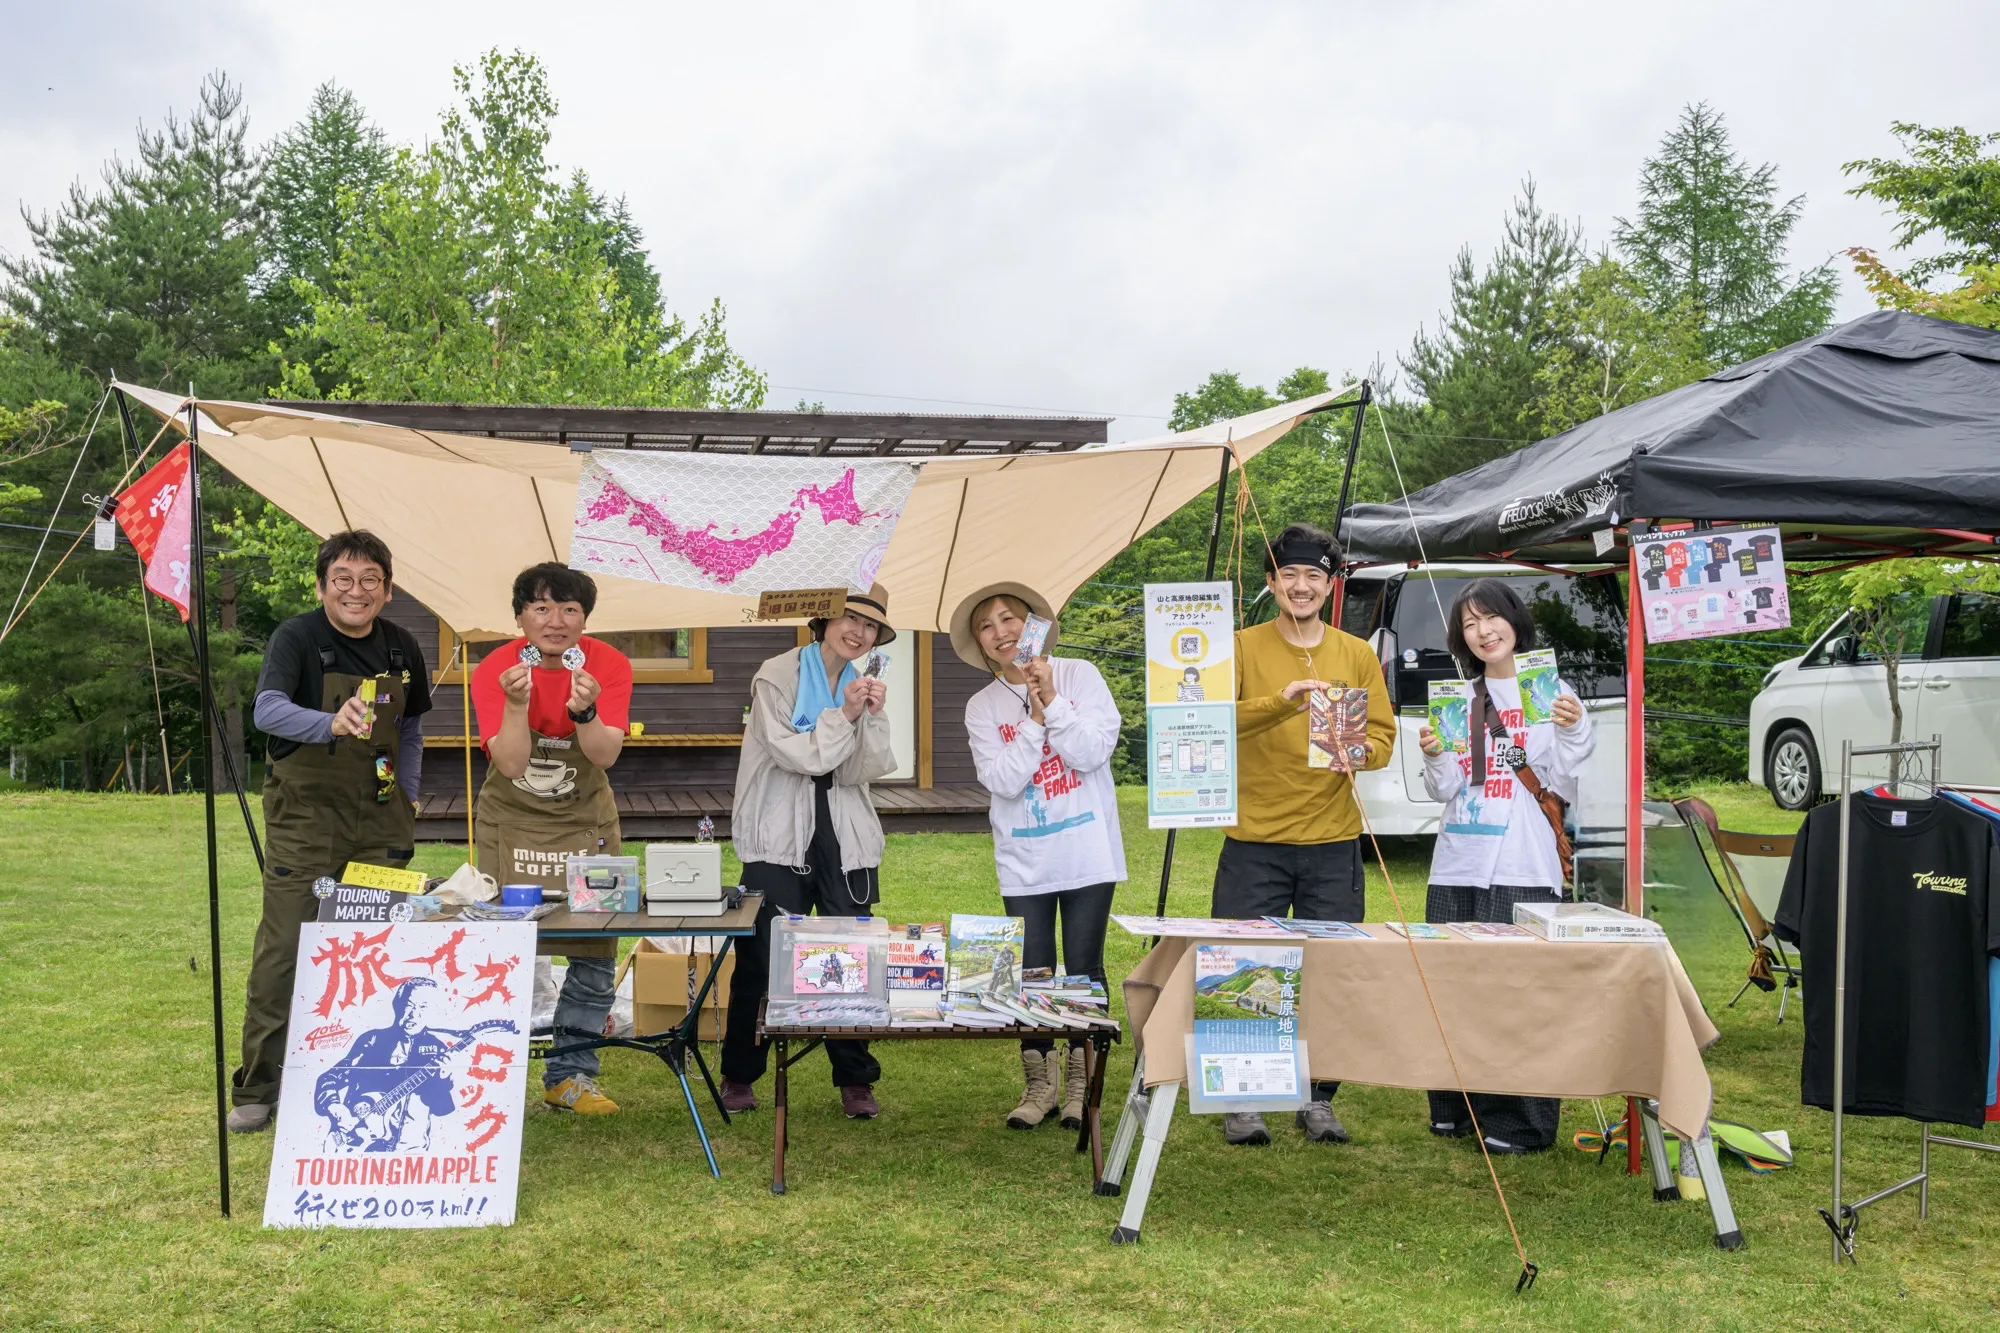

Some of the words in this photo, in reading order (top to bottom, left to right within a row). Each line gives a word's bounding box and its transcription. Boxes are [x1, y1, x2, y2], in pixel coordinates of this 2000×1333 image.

[1635, 529, 1687, 541] ツーリングマップル
[766, 592, 794, 600] 2026
[1157, 594, 1220, 602] 山と高原地図編集部
[1155, 602, 1224, 614] インスタグラム
[1044, 774, 1070, 801] FOR
[1484, 779, 1513, 799] FOR
[1912, 870, 1968, 893] Touring
[336, 888, 391, 904] TOURING
[335, 905, 387, 921] MAPPLE
[956, 917, 1021, 941] Touring
[889, 942, 902, 952] ROCK
[904, 943, 915, 953] AND
[887, 967, 902, 978] ROCK
[902, 967, 914, 978] AND
[887, 978, 930, 989] TOURINGMAPPLE
[1277, 951, 1298, 1051] 山と高原地図
[295, 1155, 498, 1186] TOURINGMAPPLE
